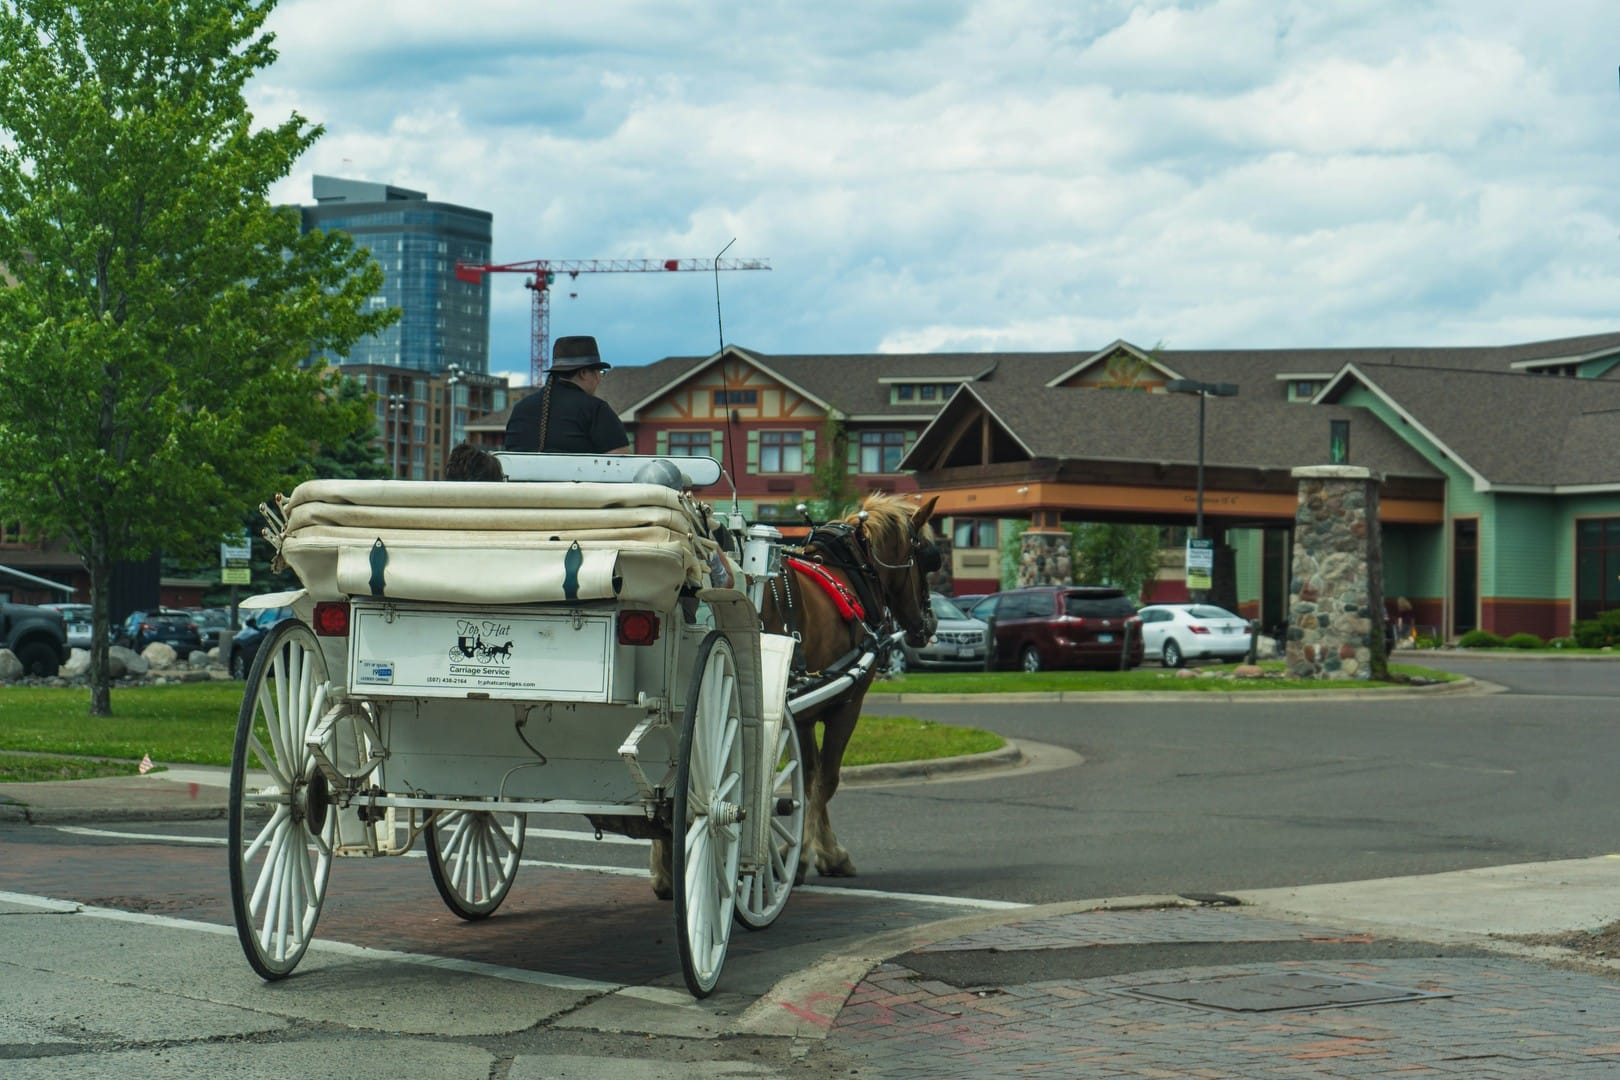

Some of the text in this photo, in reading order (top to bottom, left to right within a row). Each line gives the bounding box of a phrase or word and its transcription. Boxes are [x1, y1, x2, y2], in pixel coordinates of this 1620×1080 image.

[456, 619, 511, 637] Top Hat
[449, 665, 510, 676] Carriage Service
